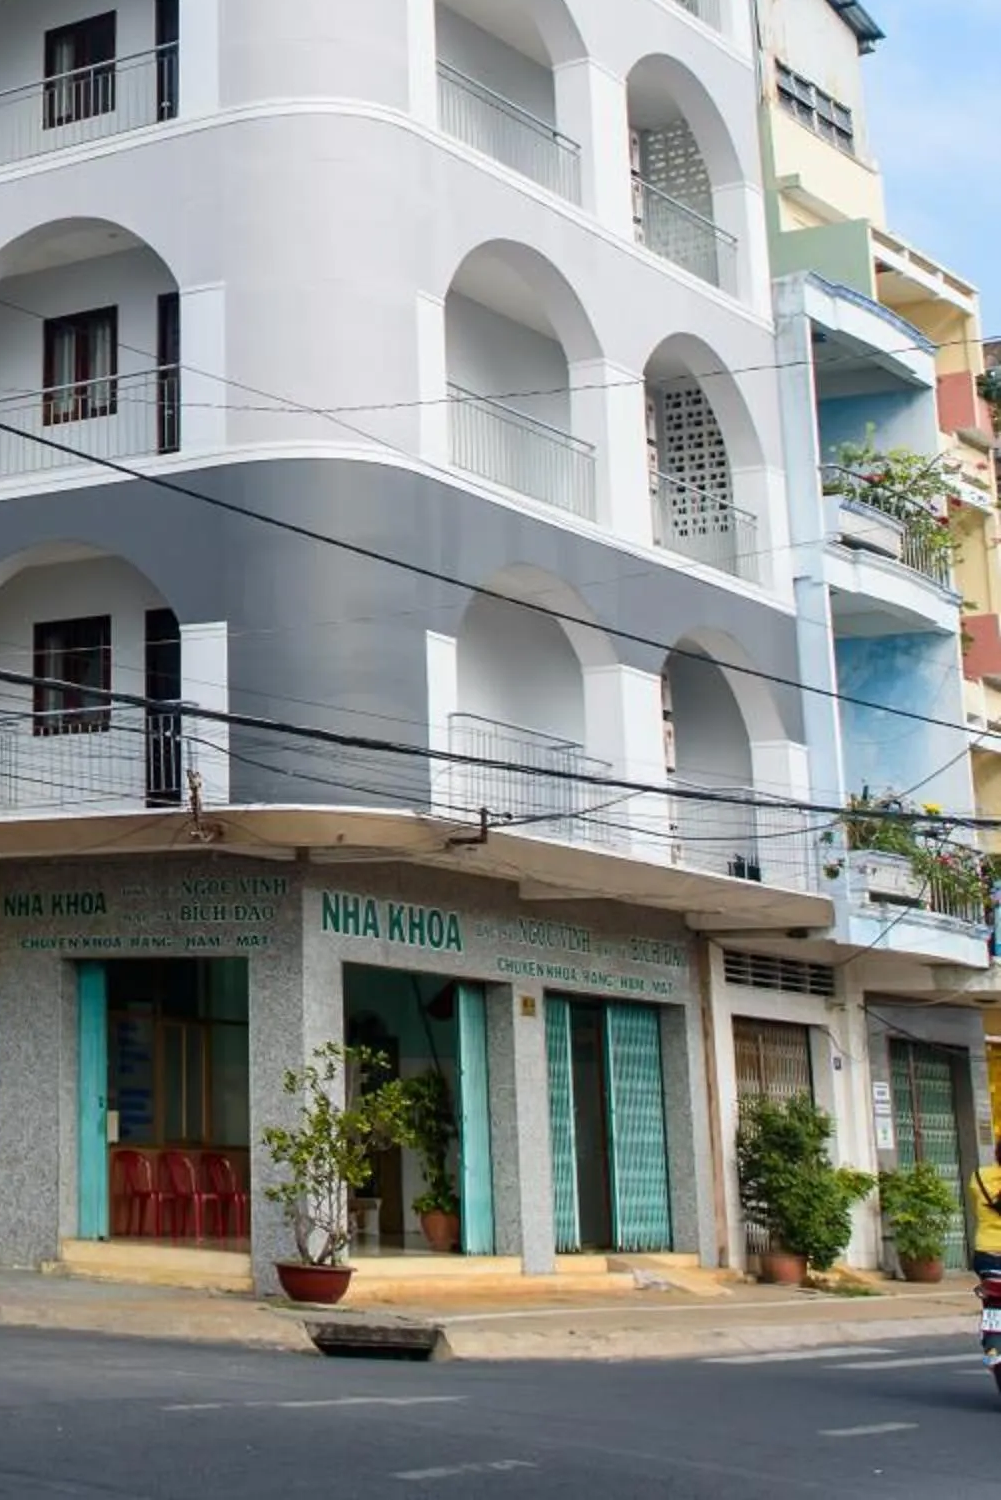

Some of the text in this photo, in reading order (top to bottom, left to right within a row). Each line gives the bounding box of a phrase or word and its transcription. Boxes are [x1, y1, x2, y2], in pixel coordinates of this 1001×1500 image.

[4, 896, 43, 917] NHA
[51, 892, 108, 915] KHOA
[322, 891, 379, 938] NHA
[388, 903, 462, 951] KHOA
